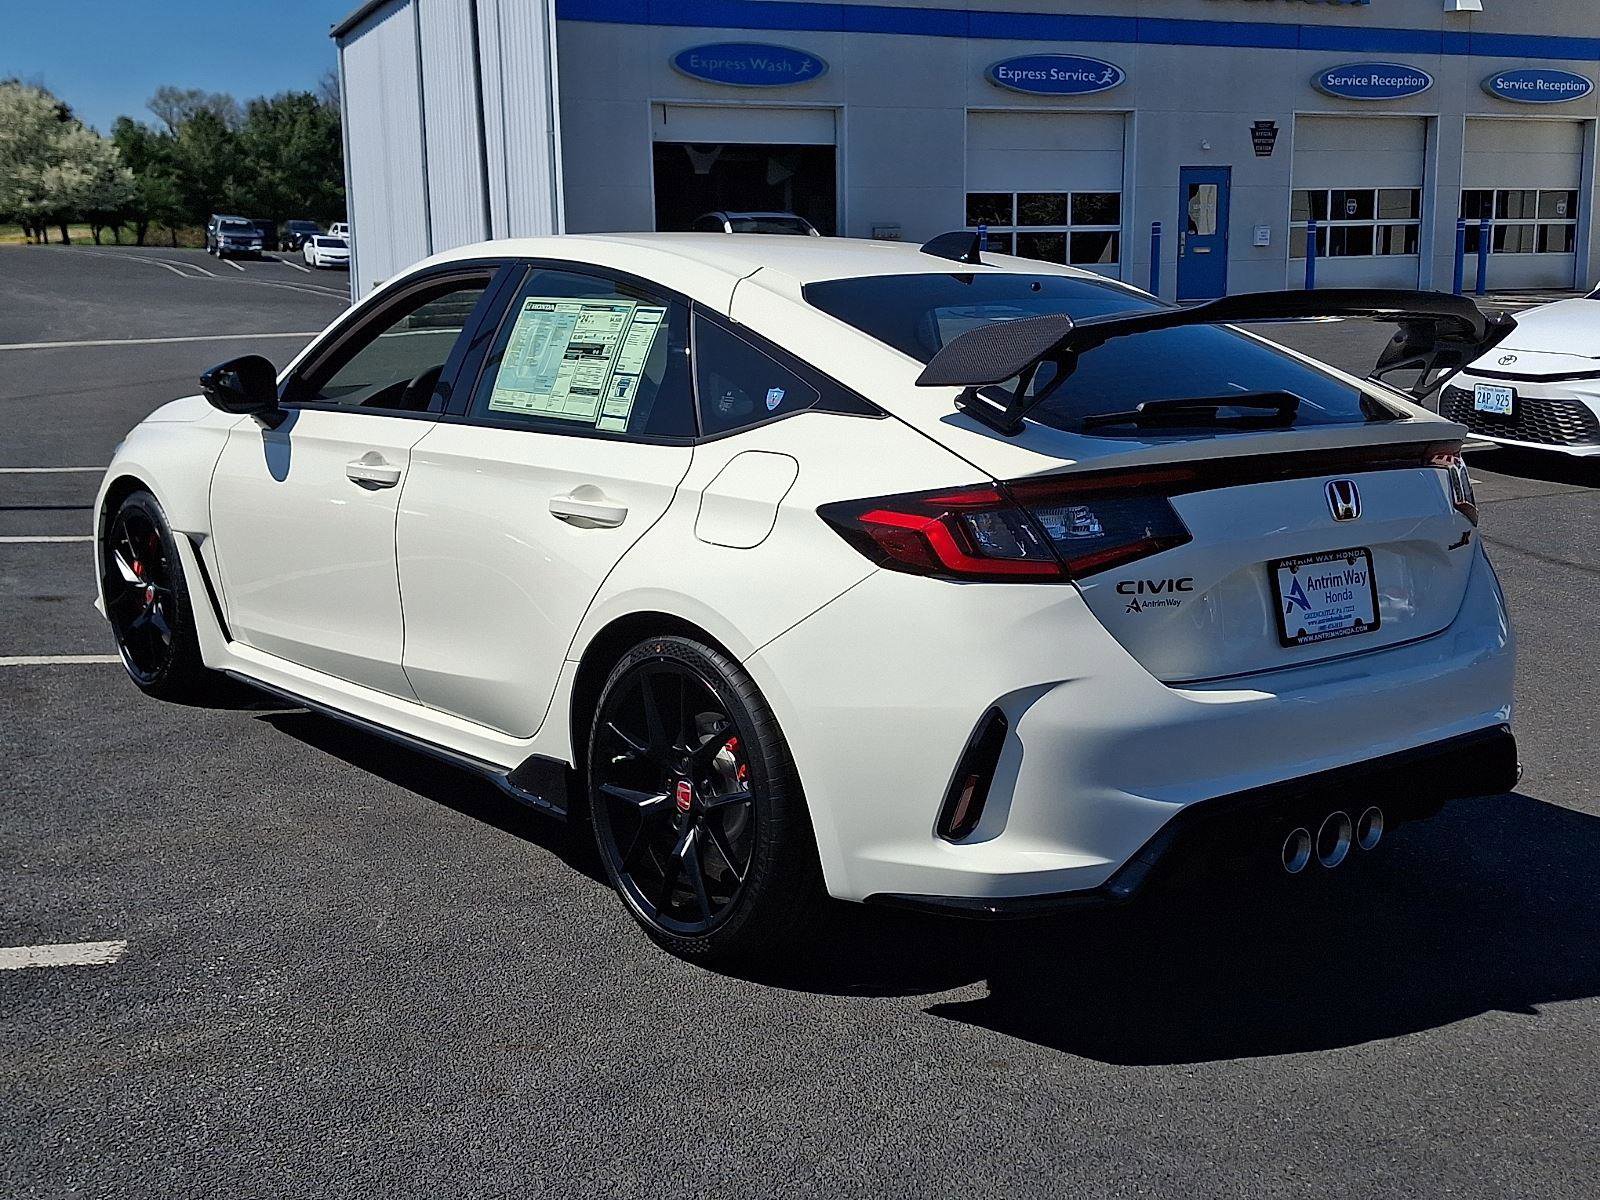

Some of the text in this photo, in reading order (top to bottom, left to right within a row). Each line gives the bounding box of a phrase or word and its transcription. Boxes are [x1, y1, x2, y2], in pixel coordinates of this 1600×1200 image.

[690, 54, 792, 72] Express Wash
[998, 66, 1097, 82] Express Service
[1327, 74, 1425, 89] Service Reception
[1496, 78, 1586, 93] Service Reception
[531, 303, 555, 311] HONDA
[1477, 391, 1510, 407] 2AP 925
[1279, 550, 1366, 568] ANTRIM WAY HONDA
[1116, 577, 1194, 595] CIVIC
[1307, 569, 1368, 592] Antrim Way
[1141, 598, 1182, 608] Antrim Way
[1325, 588, 1353, 604] Honda
